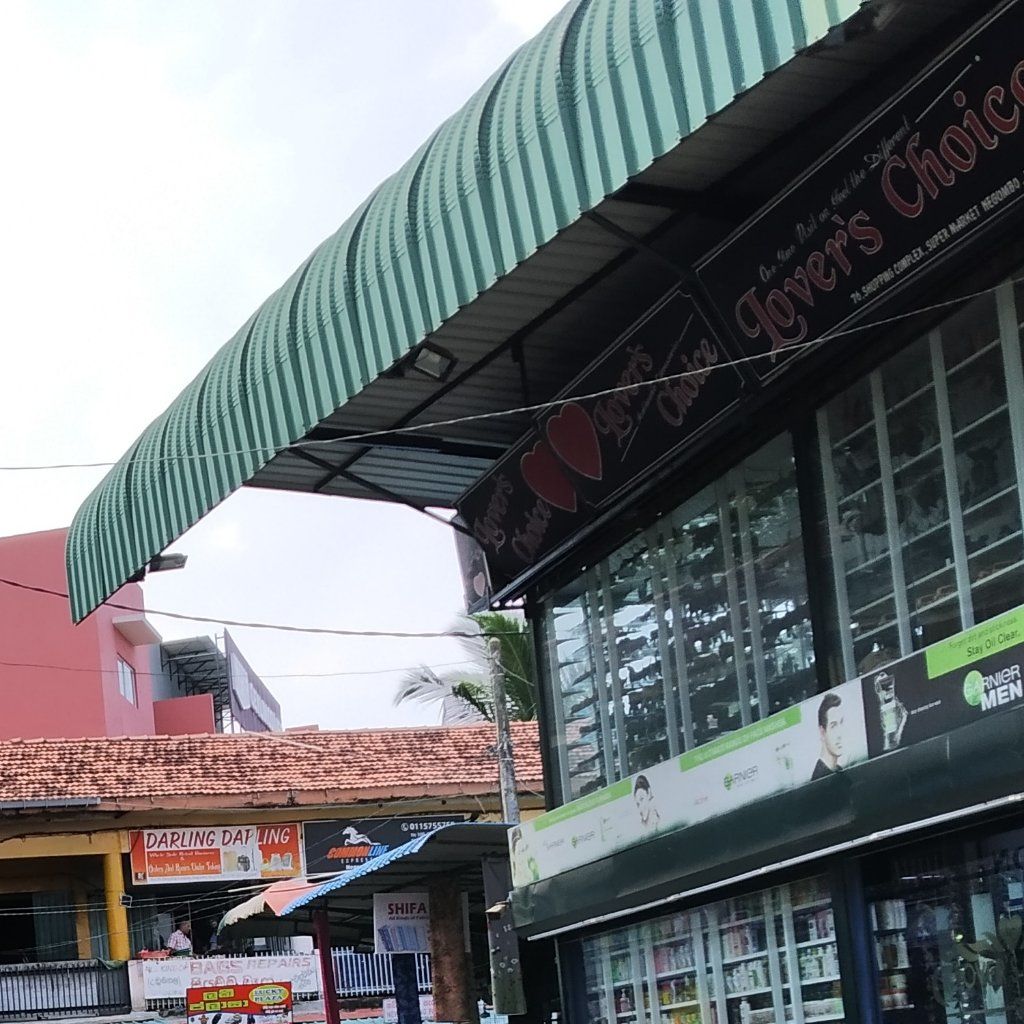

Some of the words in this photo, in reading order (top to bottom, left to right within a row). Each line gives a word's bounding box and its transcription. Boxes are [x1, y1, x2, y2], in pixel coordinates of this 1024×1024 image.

[862, 267, 895, 296] SHOPPING
[925, 227, 951, 251] SUPER
[948, 204, 981, 234] MARKET
[980, 177, 1021, 212] NEGOMBO
[734, 207, 885, 364] Lover's
[656, 337, 719, 428] Choice
[966, 646, 983, 657] Stay
[985, 639, 996, 649] Oil
[980, 680, 1023, 712] MEN
[146, 830, 216, 850] DARLING
[387, 902, 427, 915] SHIFA
[189, 961, 243, 976] BAGS
[247, 957, 311, 970] REPAIRS
[254, 988, 283, 996] LUCKY
